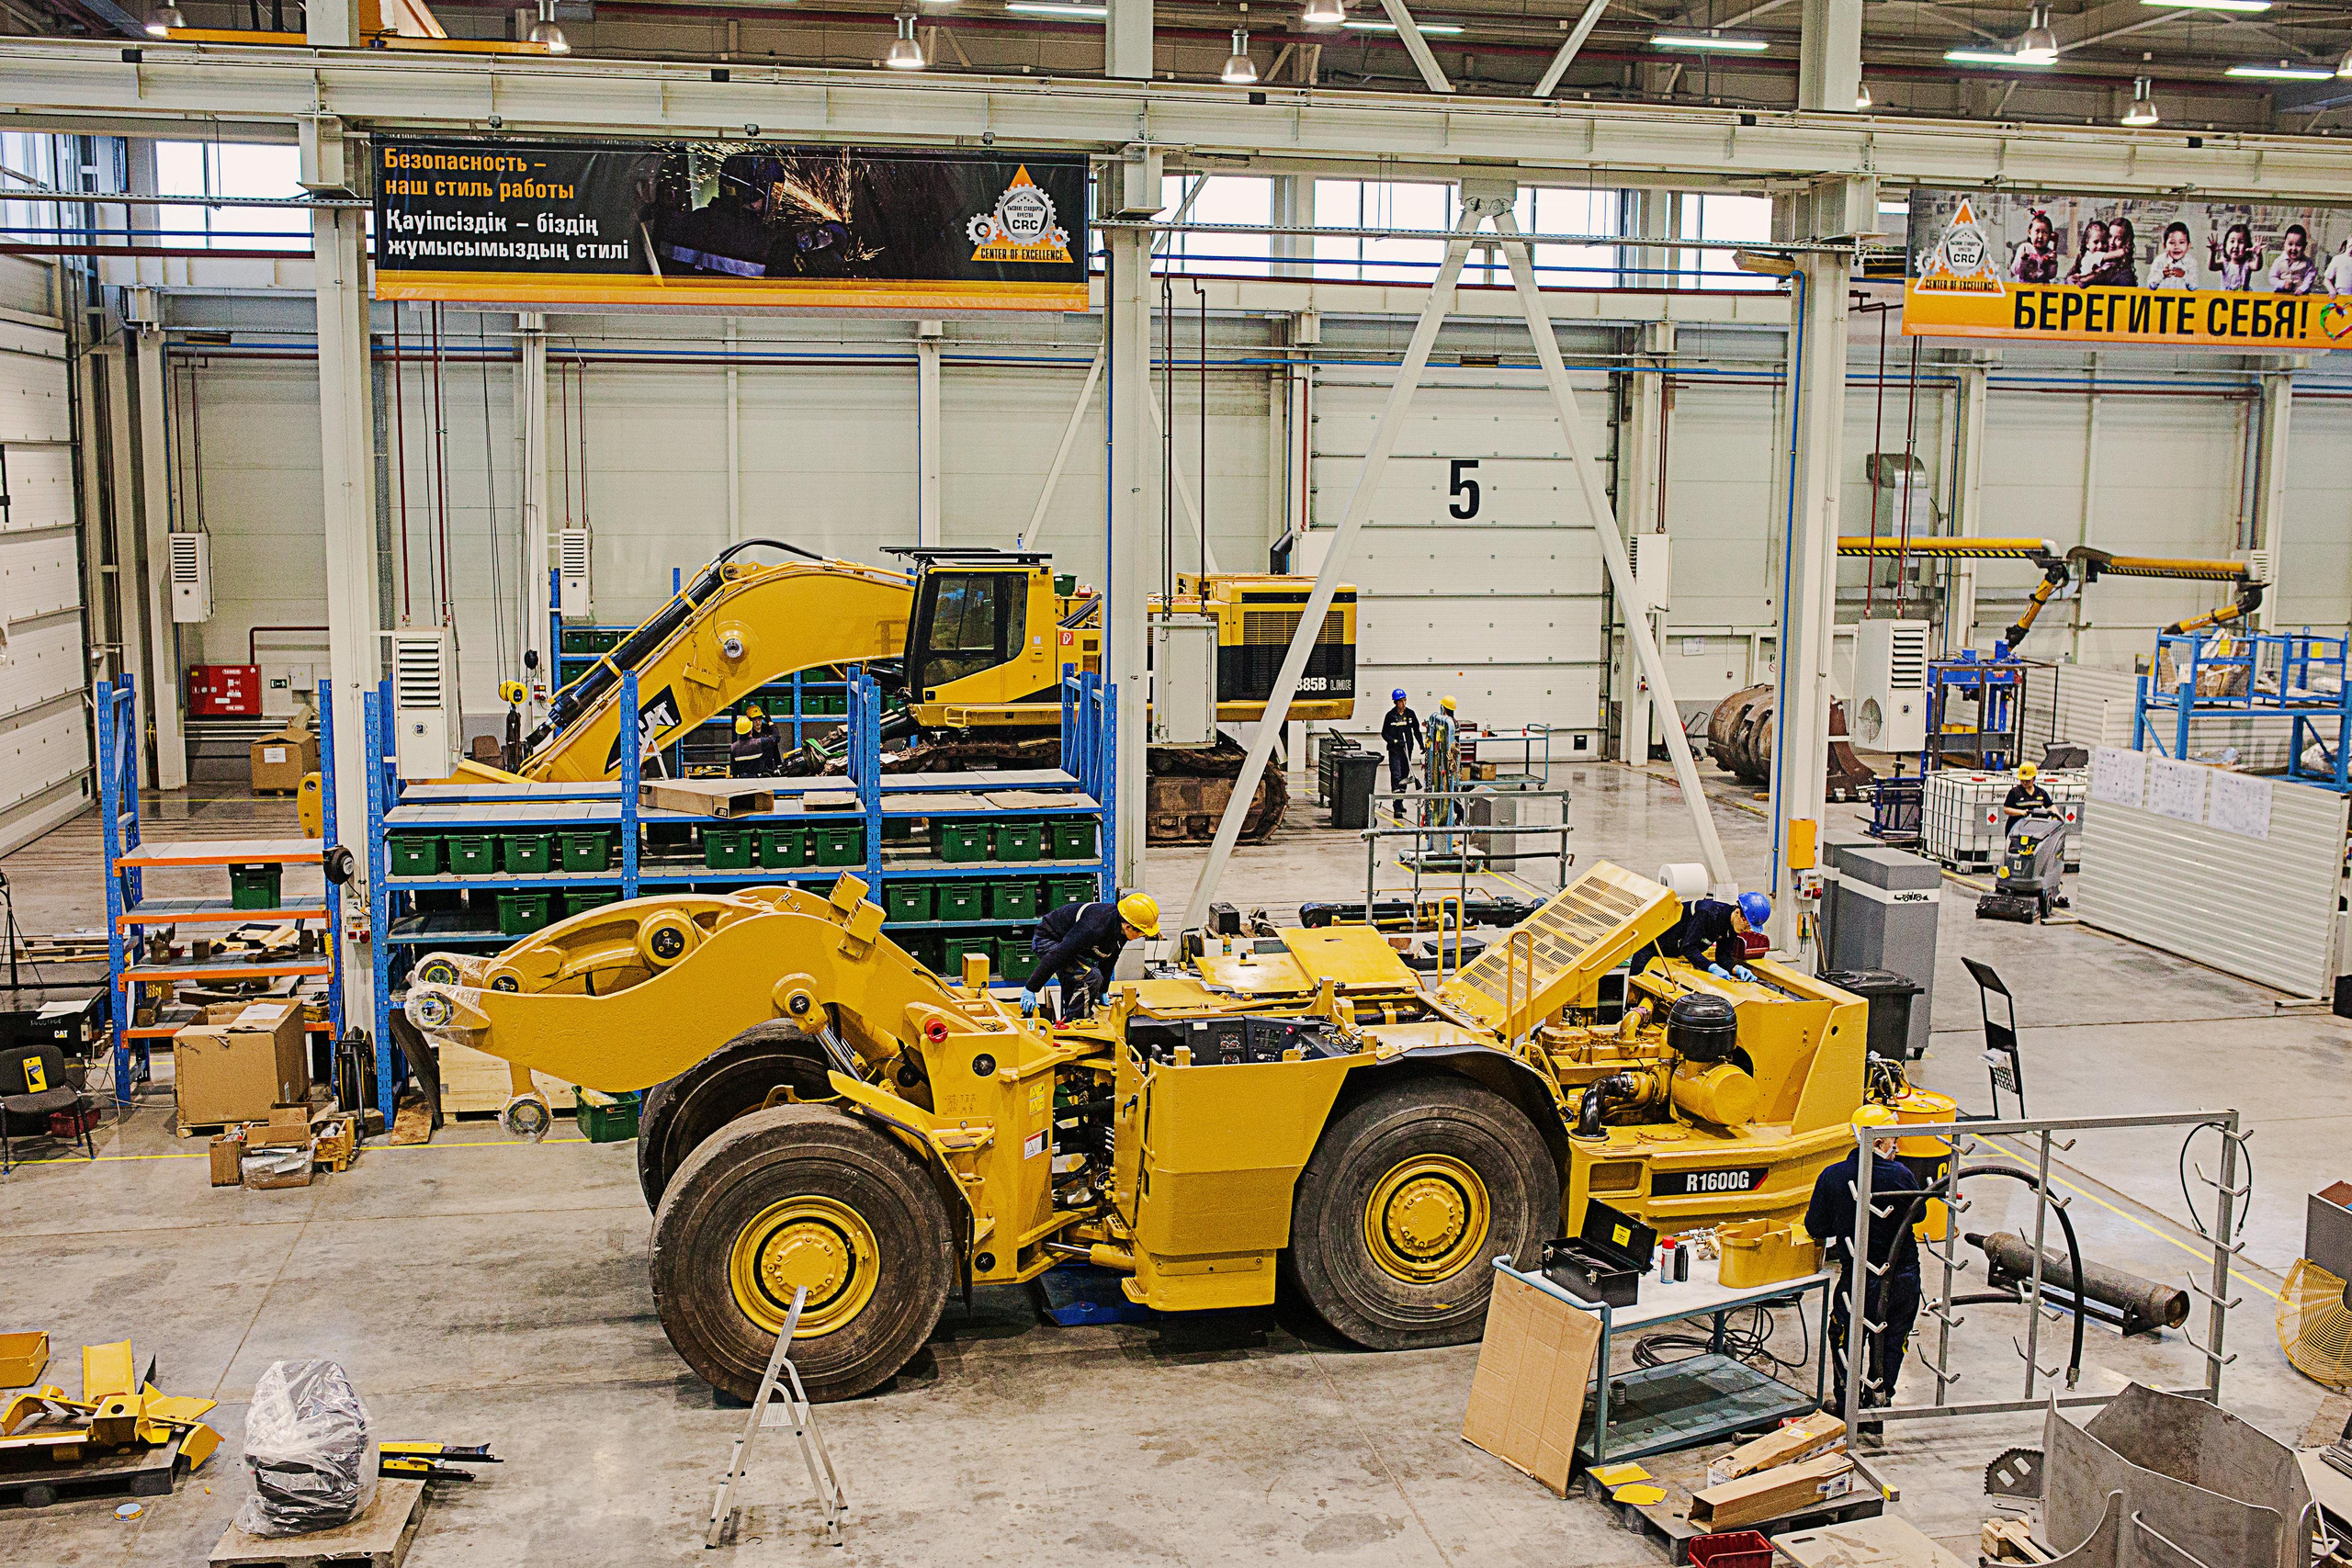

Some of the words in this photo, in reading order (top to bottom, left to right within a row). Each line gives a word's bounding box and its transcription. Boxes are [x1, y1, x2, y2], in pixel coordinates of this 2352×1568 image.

[384, 148, 527, 172] Безопасность
[385, 179, 429, 196] наш
[435, 181, 493, 197] стиль
[499, 179, 575, 202] работы
[386, 209, 507, 235] Қауіпсіздік
[537, 212, 599, 237] біздің
[1012, 220, 1038, 230] CRC
[388, 239, 570, 261] жұмысымыздың
[575, 240, 629, 259] стилі
[980, 248, 1007, 259] CENTER
[1010, 249, 1019, 260] OF
[1022, 249, 1064, 261] EXCELLENCE
[1953, 254, 1975, 264] CRC
[1925, 279, 1948, 290] CENTER
[1951, 280, 1957, 290] OF
[1960, 280, 1995, 292] EXCELLENCE
[2014, 290, 2196, 335] БЕРЕГИТЕ
[2207, 298, 2309, 339] СЕБЯ!
[1449, 459, 1480, 519] 5
[54, 1030, 69, 1038] CAT
[1686, 1171, 1749, 1191] R1600G
